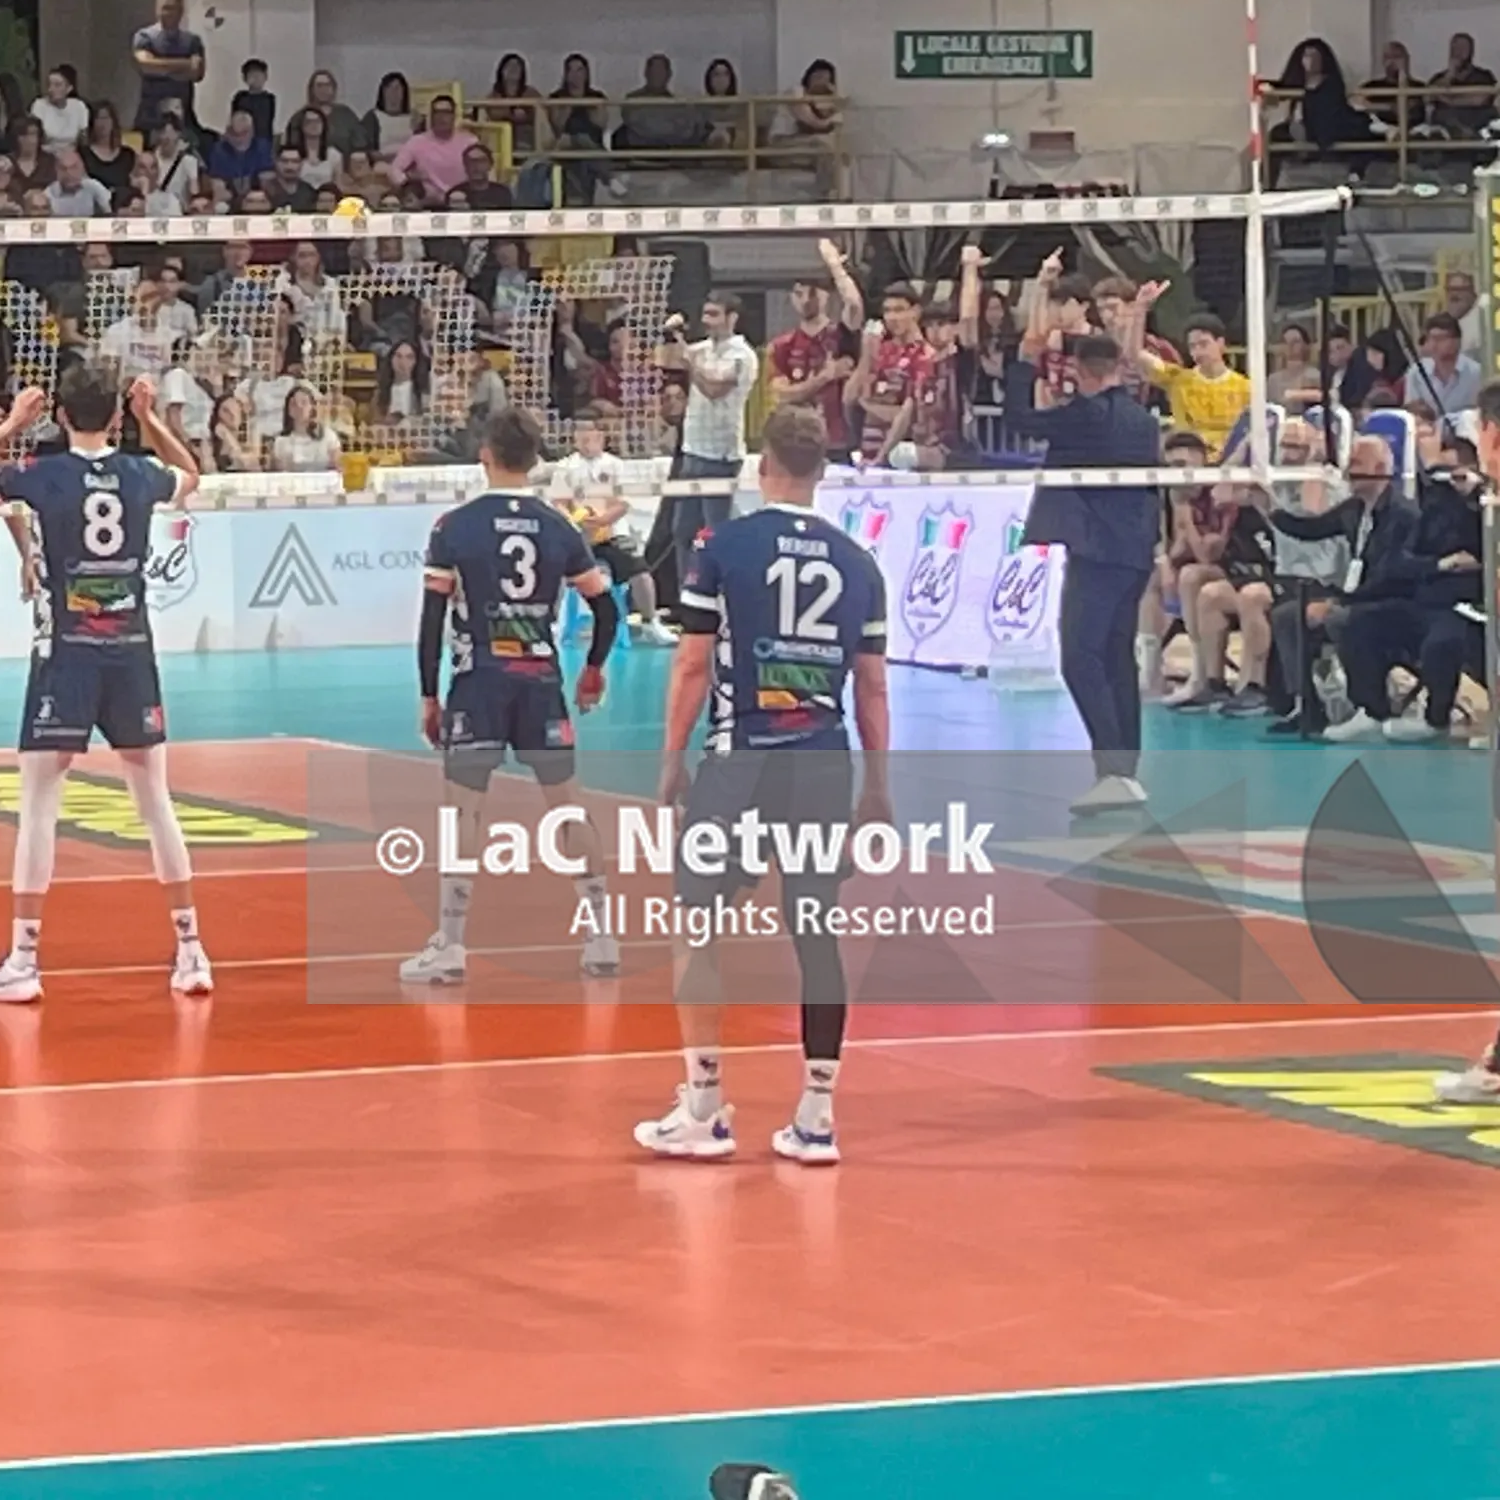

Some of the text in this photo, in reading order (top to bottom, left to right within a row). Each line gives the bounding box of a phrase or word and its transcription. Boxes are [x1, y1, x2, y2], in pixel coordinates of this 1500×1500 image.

[83, 490, 125, 558] 8
[378, 549, 424, 571] CON
[500, 534, 537, 601] 3
[765, 555, 844, 641] 12
